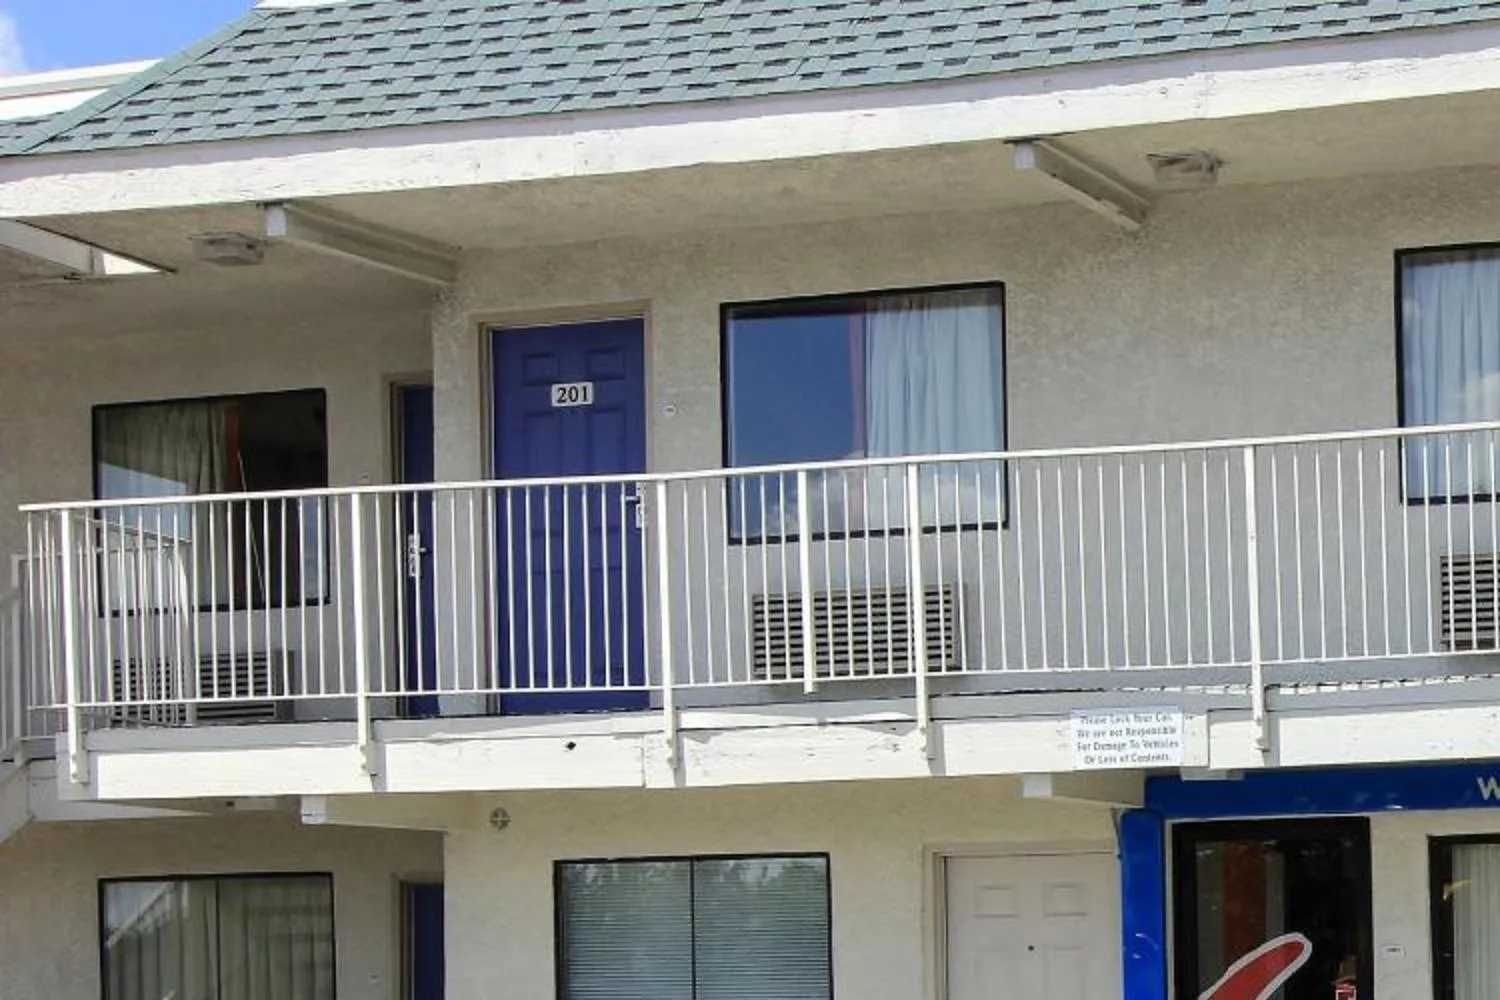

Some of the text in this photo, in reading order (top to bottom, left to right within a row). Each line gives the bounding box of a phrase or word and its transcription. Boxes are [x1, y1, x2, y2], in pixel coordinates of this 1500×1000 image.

[557, 386, 588, 403] 201
[1126, 726, 1176, 736] Responsible
[1093, 742, 1127, 752] Damage
